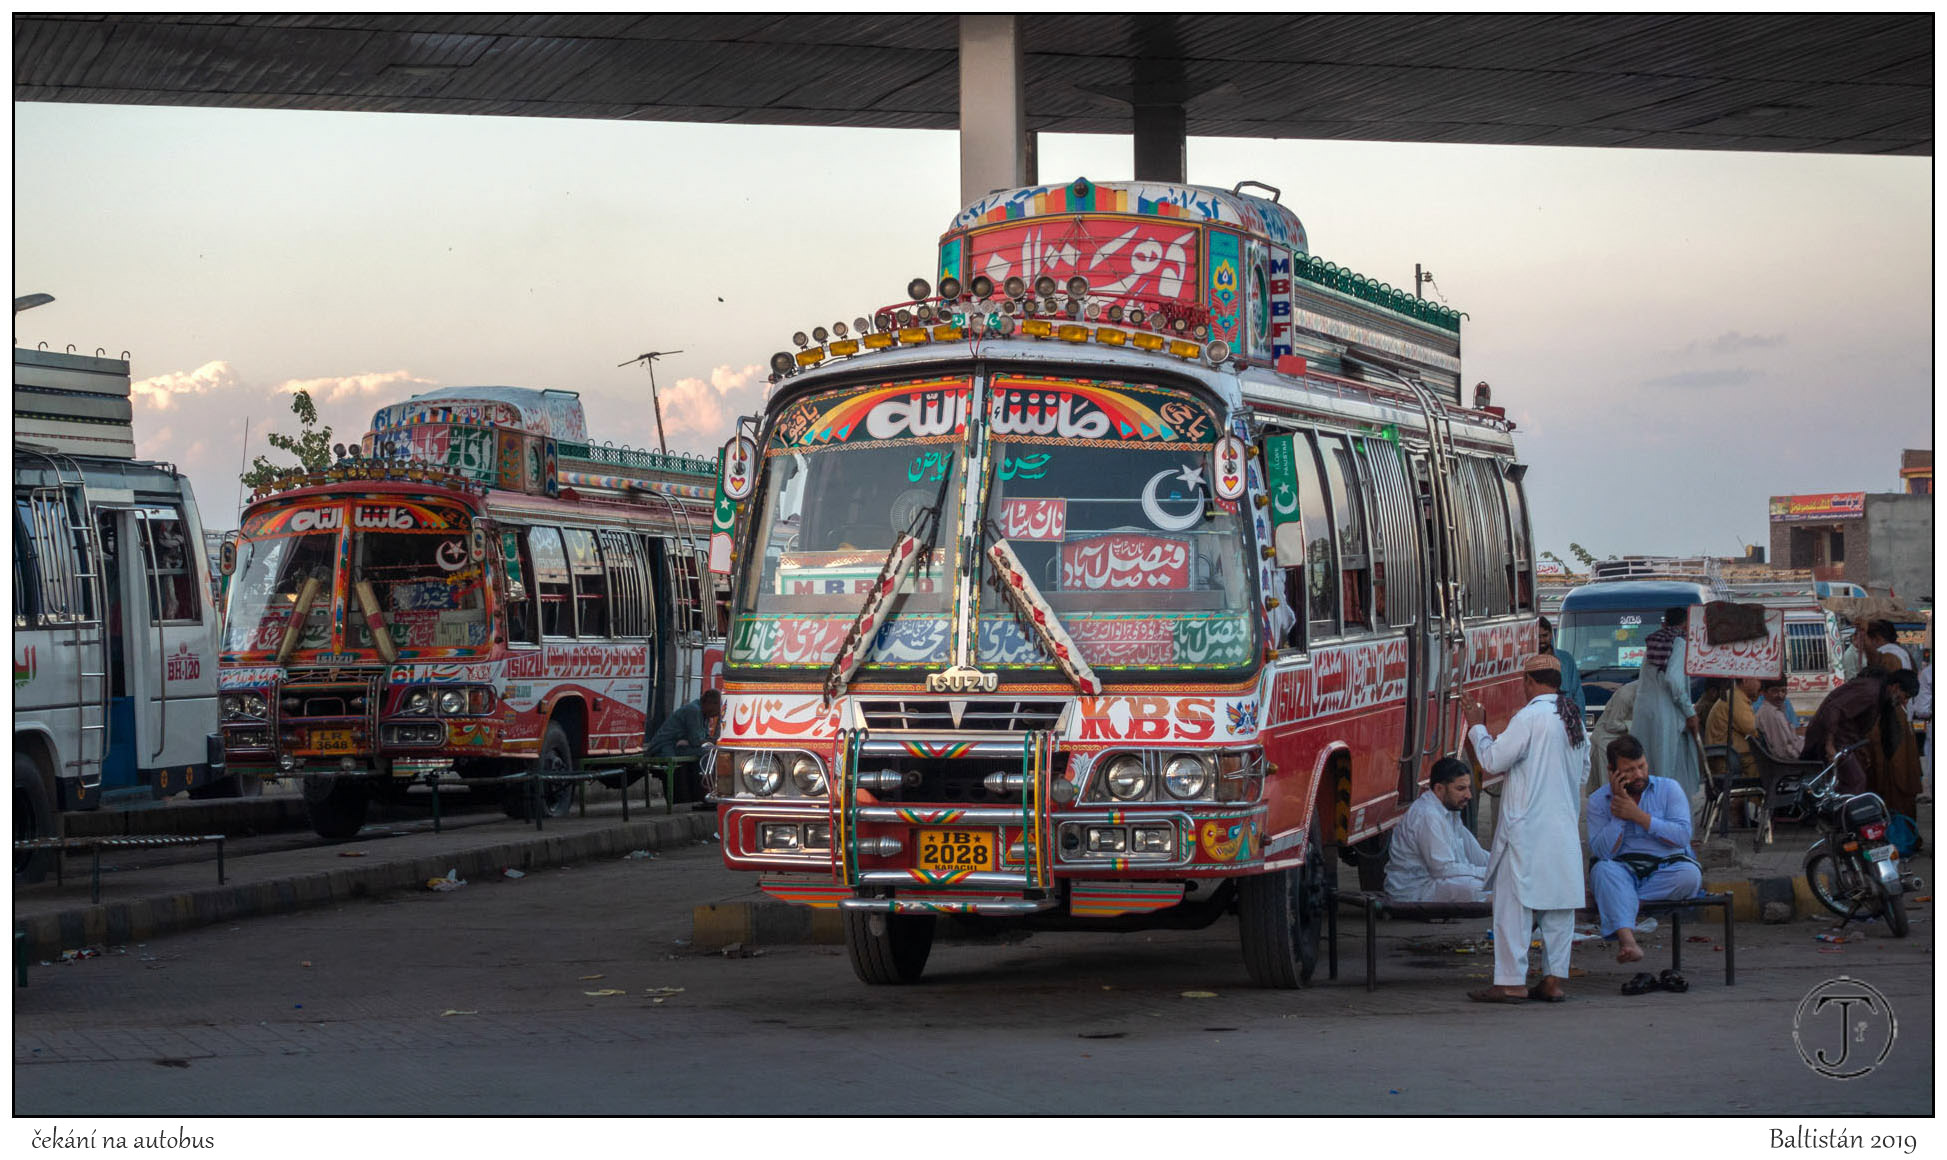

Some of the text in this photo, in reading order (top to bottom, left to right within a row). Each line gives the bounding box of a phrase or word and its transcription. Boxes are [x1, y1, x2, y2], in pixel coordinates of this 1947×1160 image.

[507, 653, 544, 678] ISUZU
[925, 673, 998, 693] ISUZU
[1079, 696, 1217, 740] KBS
[924, 844, 988, 864] 2028
